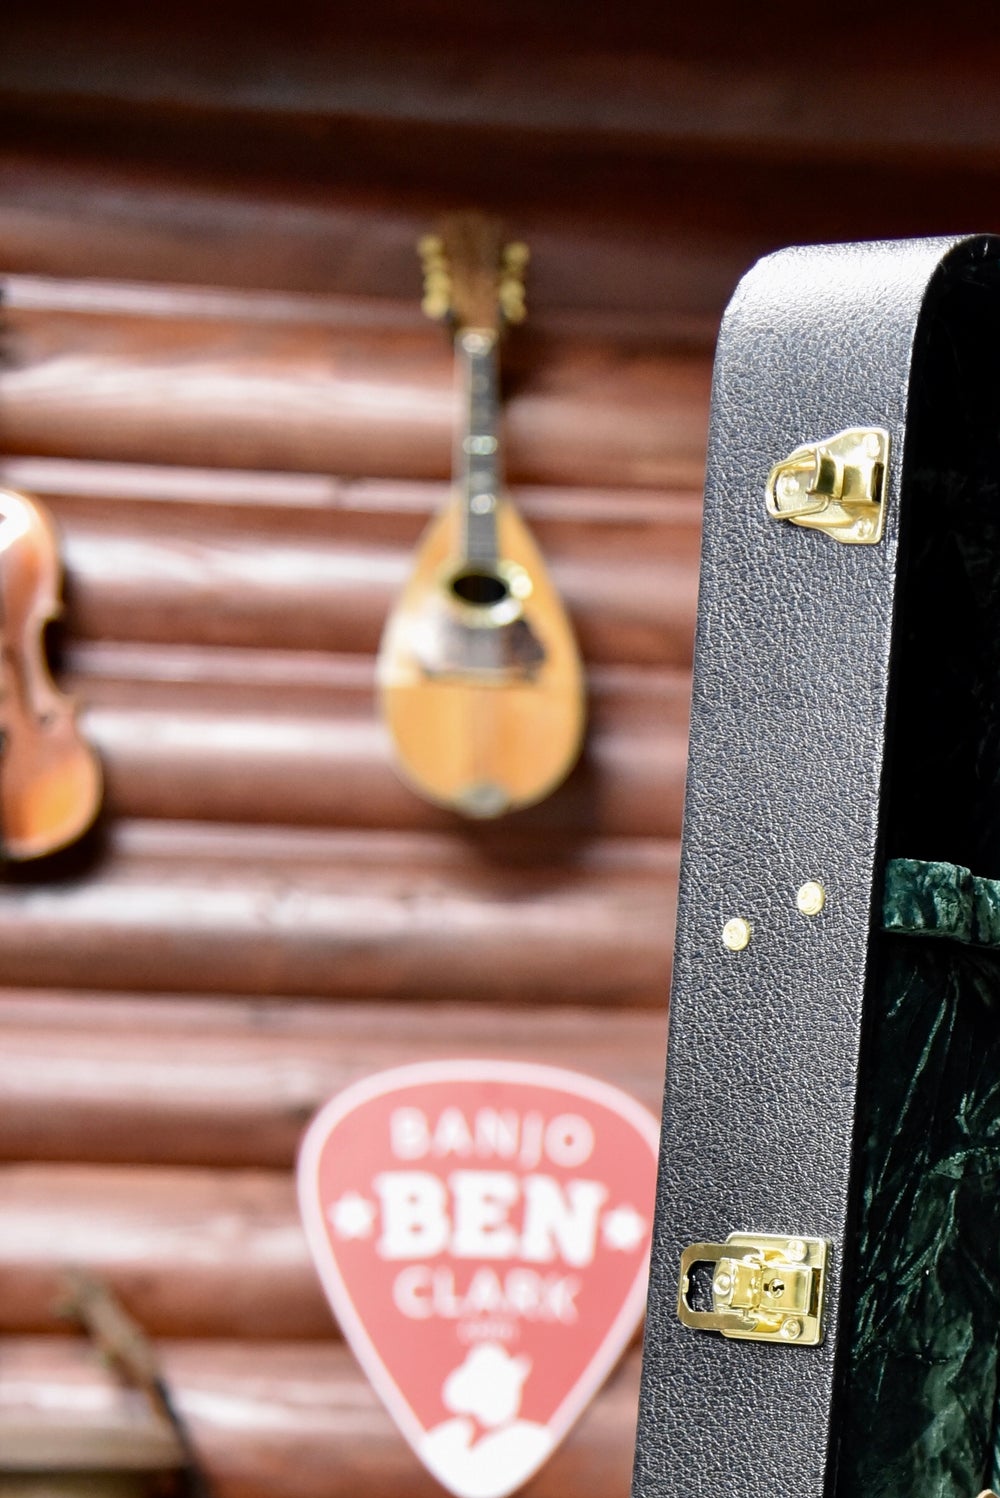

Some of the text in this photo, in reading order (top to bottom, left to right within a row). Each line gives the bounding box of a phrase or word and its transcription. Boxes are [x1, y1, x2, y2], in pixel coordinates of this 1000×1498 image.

[391, 1107, 594, 1168] BANJO
[374, 1171, 607, 1266] BEN
[394, 1267, 580, 1322] CLARK
